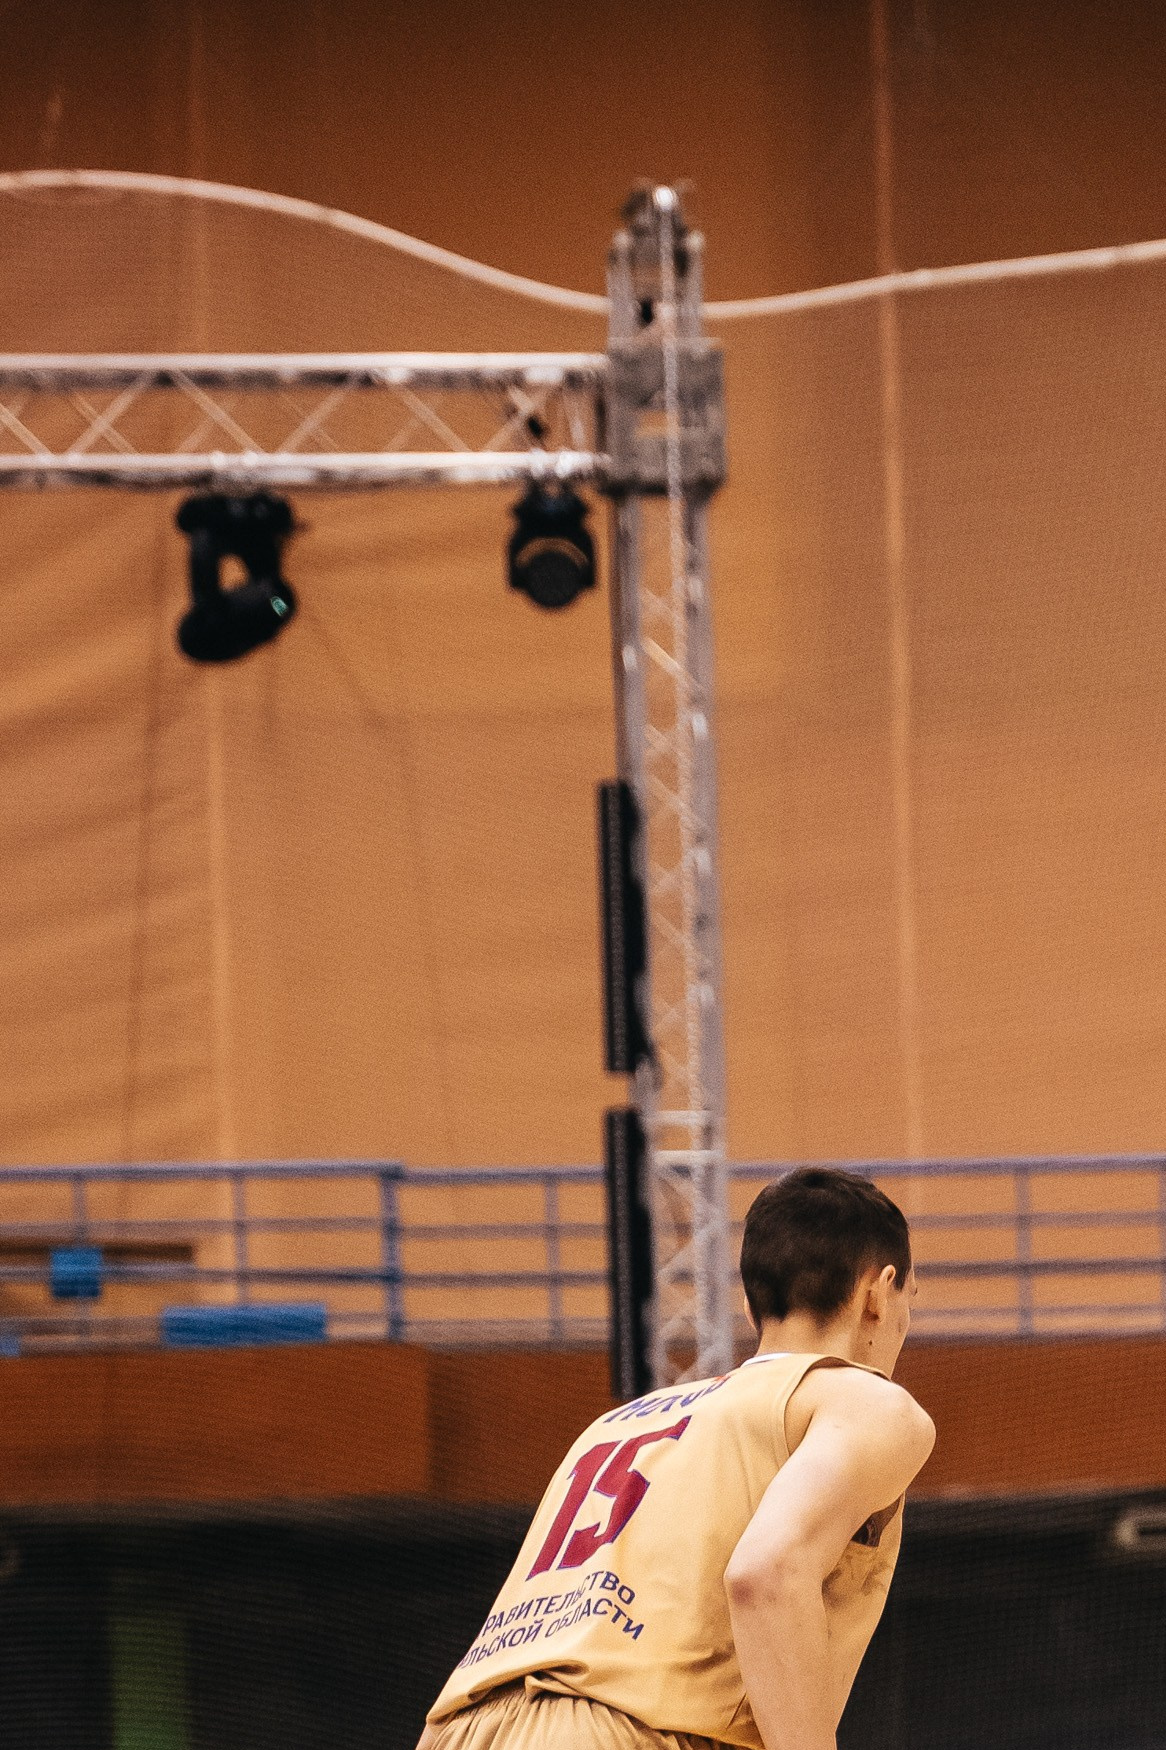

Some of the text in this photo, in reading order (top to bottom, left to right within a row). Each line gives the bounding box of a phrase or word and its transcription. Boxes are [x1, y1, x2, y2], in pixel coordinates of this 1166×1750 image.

[525, 1415, 692, 1582] 15
[457, 1598, 645, 1669] ЛЬСКОЙ ОБЛАСТИ
[482, 1571, 636, 1637] РАВИТЕЛЬСТВО
